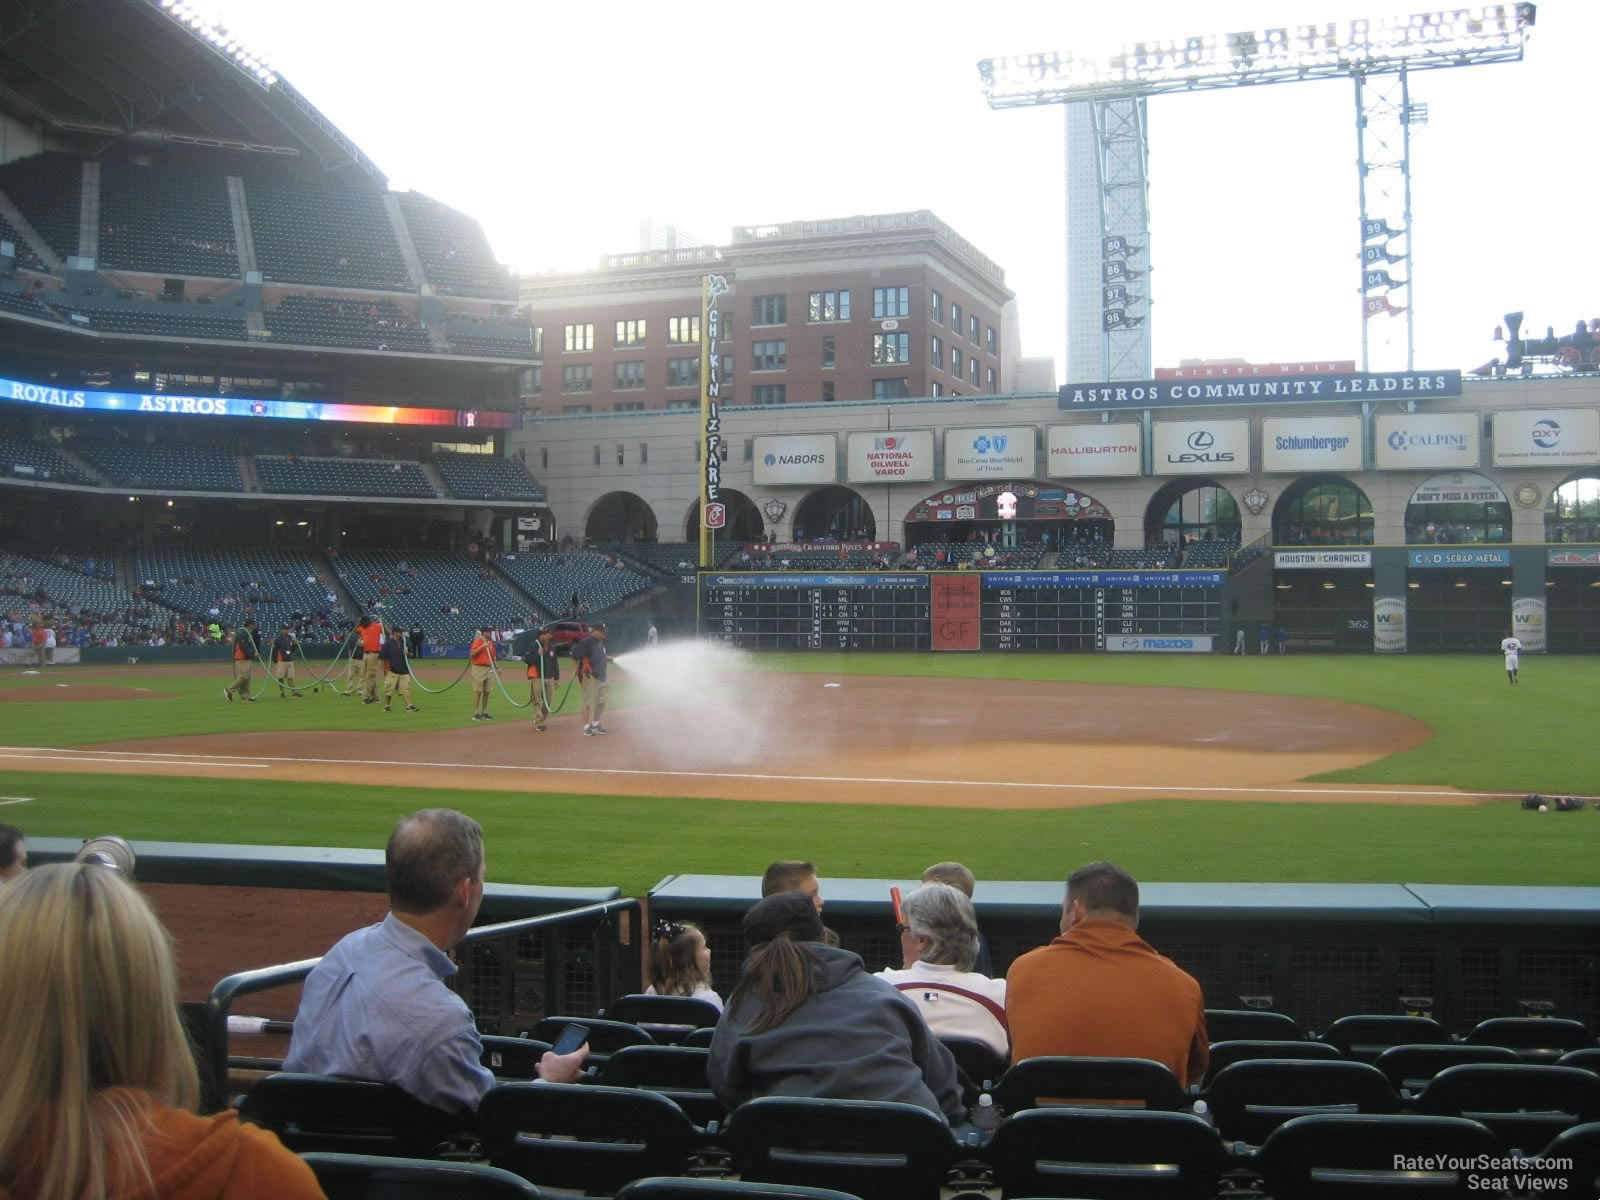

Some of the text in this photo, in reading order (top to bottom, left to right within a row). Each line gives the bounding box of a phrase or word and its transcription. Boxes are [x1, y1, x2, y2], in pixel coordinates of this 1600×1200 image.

[1366, 223, 1381, 235] 99
[1107, 240, 1121, 251] 80
[1367, 248, 1380, 260] 01
[1107, 264, 1120, 275] 86
[1368, 274, 1382, 285] 04
[1107, 288, 1119, 300] 97
[1368, 300, 1382, 311] 05
[1107, 312, 1120, 323] 98
[709, 310, 720, 397] CHIKIN
[1175, 364, 1336, 378] MINUTE MAID
[1072, 376, 1447, 402] ASTROS COMMUNITY LEADERS
[12, 382, 85, 408] ROYALS
[139, 396, 226, 415] ASTROS
[1532, 430, 1560, 438] OXY
[1275, 436, 1349, 451] Schlumberger
[1409, 434, 1467, 446] CALPINE
[1050, 445, 1137, 455] HALLIBURTON
[778, 454, 825, 464] NABORS
[866, 452, 913, 460] NATIONAL
[1167, 453, 1234, 463] LEXUS
[708, 435, 720, 500] FARE
[870, 460, 910, 468] OILWELL
[1442, 492, 1461, 500] MISS
[803, 543, 840, 551] CRAWFORD
[1280, 554, 1366, 563] HOUSTON CHRONICLE
[1415, 554, 1423, 563] C
[1433, 554, 1442, 564] D
[1446, 554, 1473, 563] SCRAP
[1475, 553, 1503, 562] METAL
[680, 575, 696, 584] 315
[813, 591, 821, 648] NATIONAL
[1348, 620, 1369, 629] 362
[939, 622, 970, 640] GF
[1143, 639, 1192, 649] mazda
[1506, 642, 1517, 651] 42
